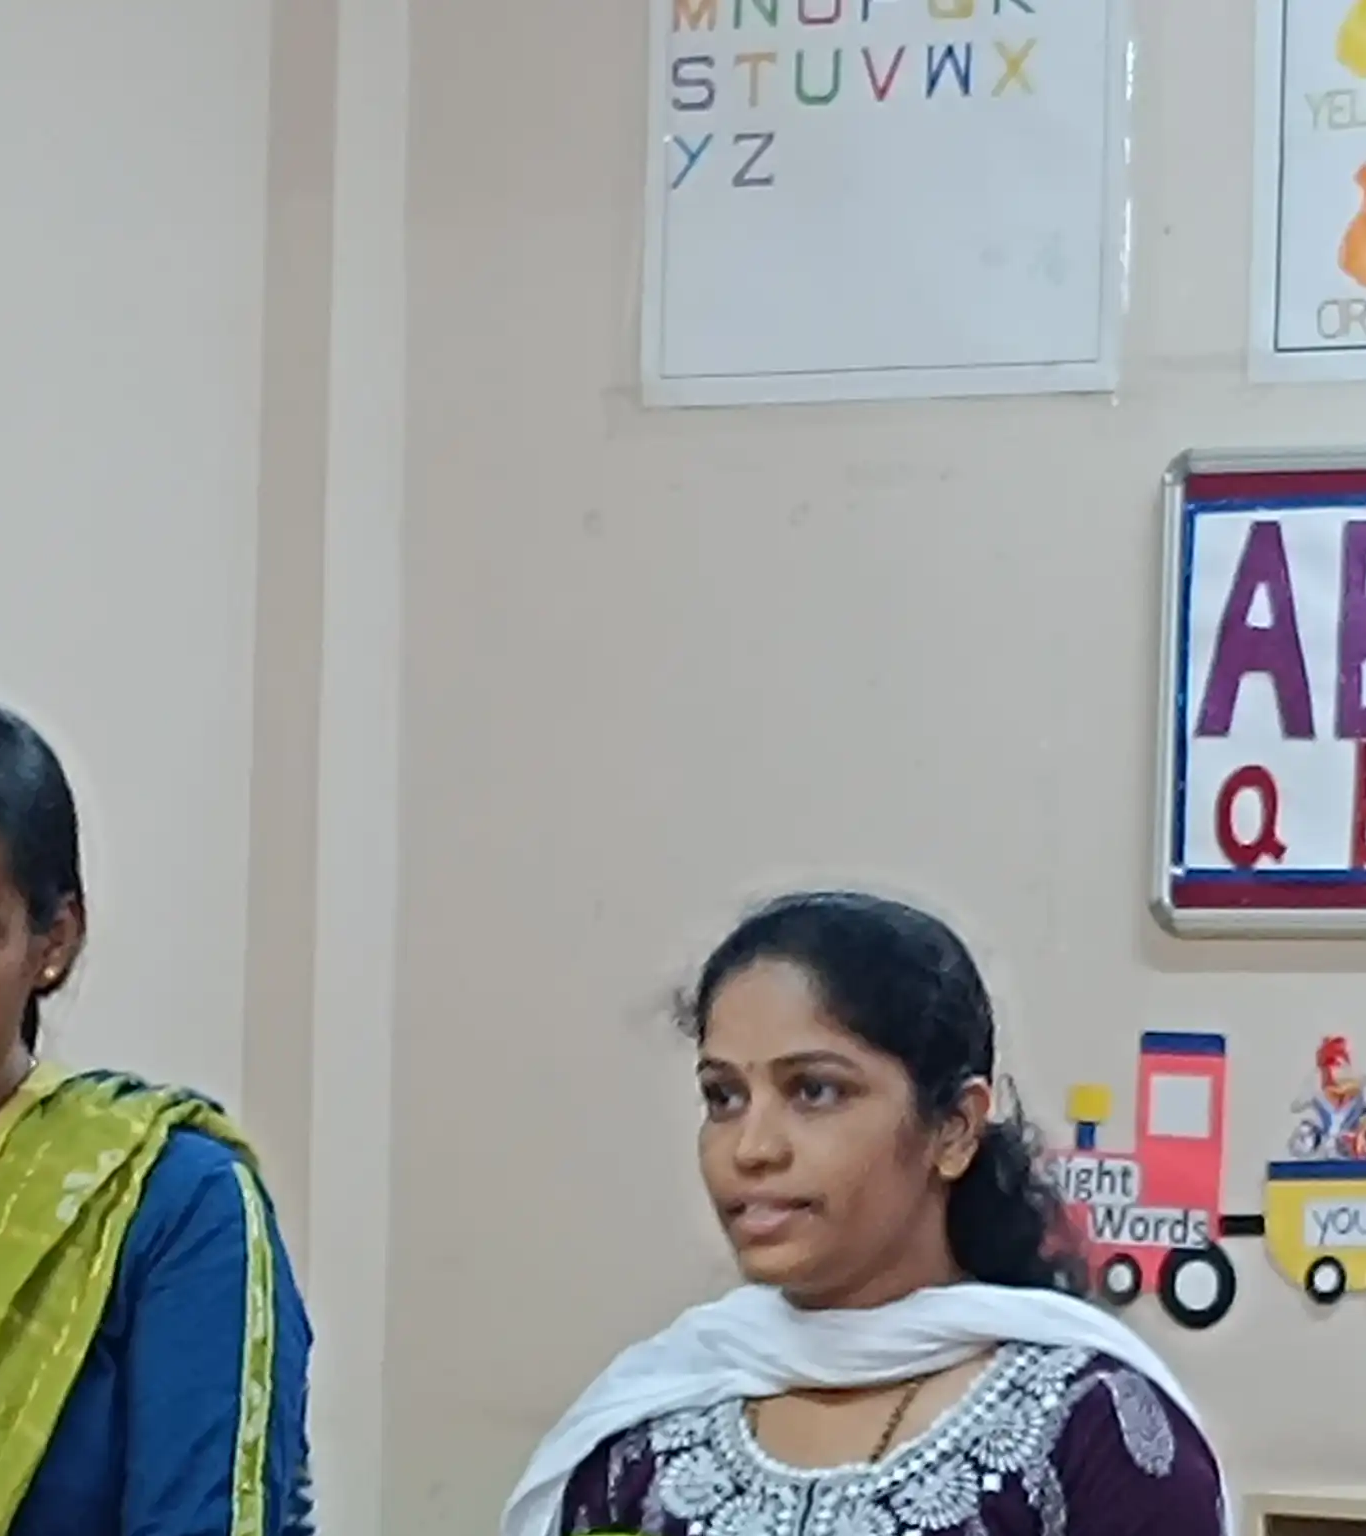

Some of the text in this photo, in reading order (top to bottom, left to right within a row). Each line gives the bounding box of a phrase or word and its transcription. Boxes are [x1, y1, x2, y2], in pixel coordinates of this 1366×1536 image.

[671, 38, 1036, 111] S T U V W X
[671, 132, 775, 189] Y Z
[1214, 764, 1286, 868] a
[1055, 1160, 1132, 1201] ight
[1093, 1204, 1208, 1246] Words
